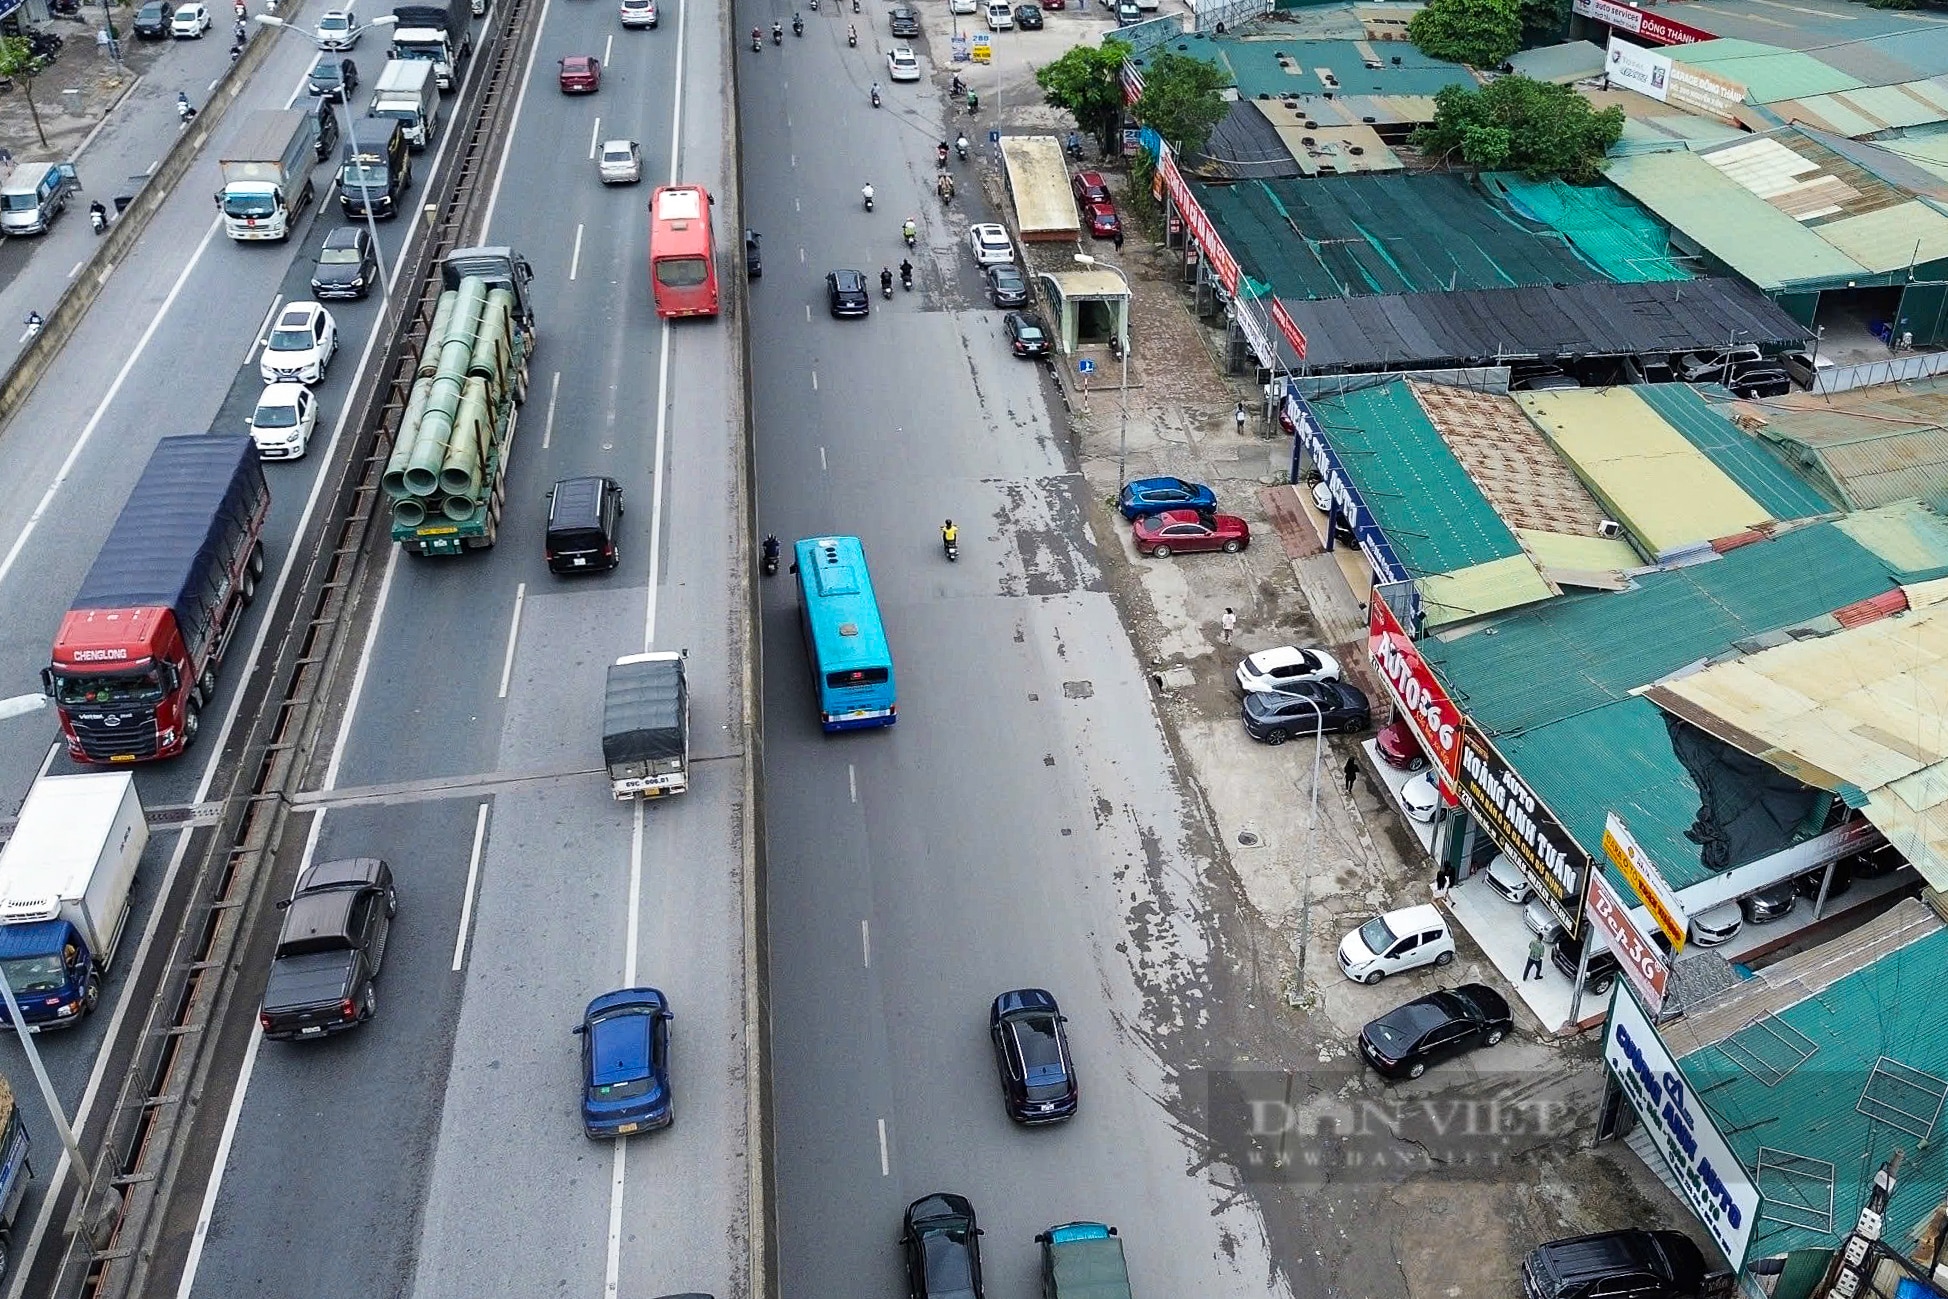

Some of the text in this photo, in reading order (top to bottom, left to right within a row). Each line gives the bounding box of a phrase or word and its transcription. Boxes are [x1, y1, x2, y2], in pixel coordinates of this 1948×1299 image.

[74, 648, 128, 662] CHENGLONG
[1377, 630, 1455, 751] AUTO366
[1462, 745, 1507, 811] HOÀNG
[1505, 797, 1537, 848] ANH
[1502, 769, 1535, 814] AUTO
[1661, 1101, 1698, 1163] ANH
[1696, 1156, 1742, 1230] AUTO
